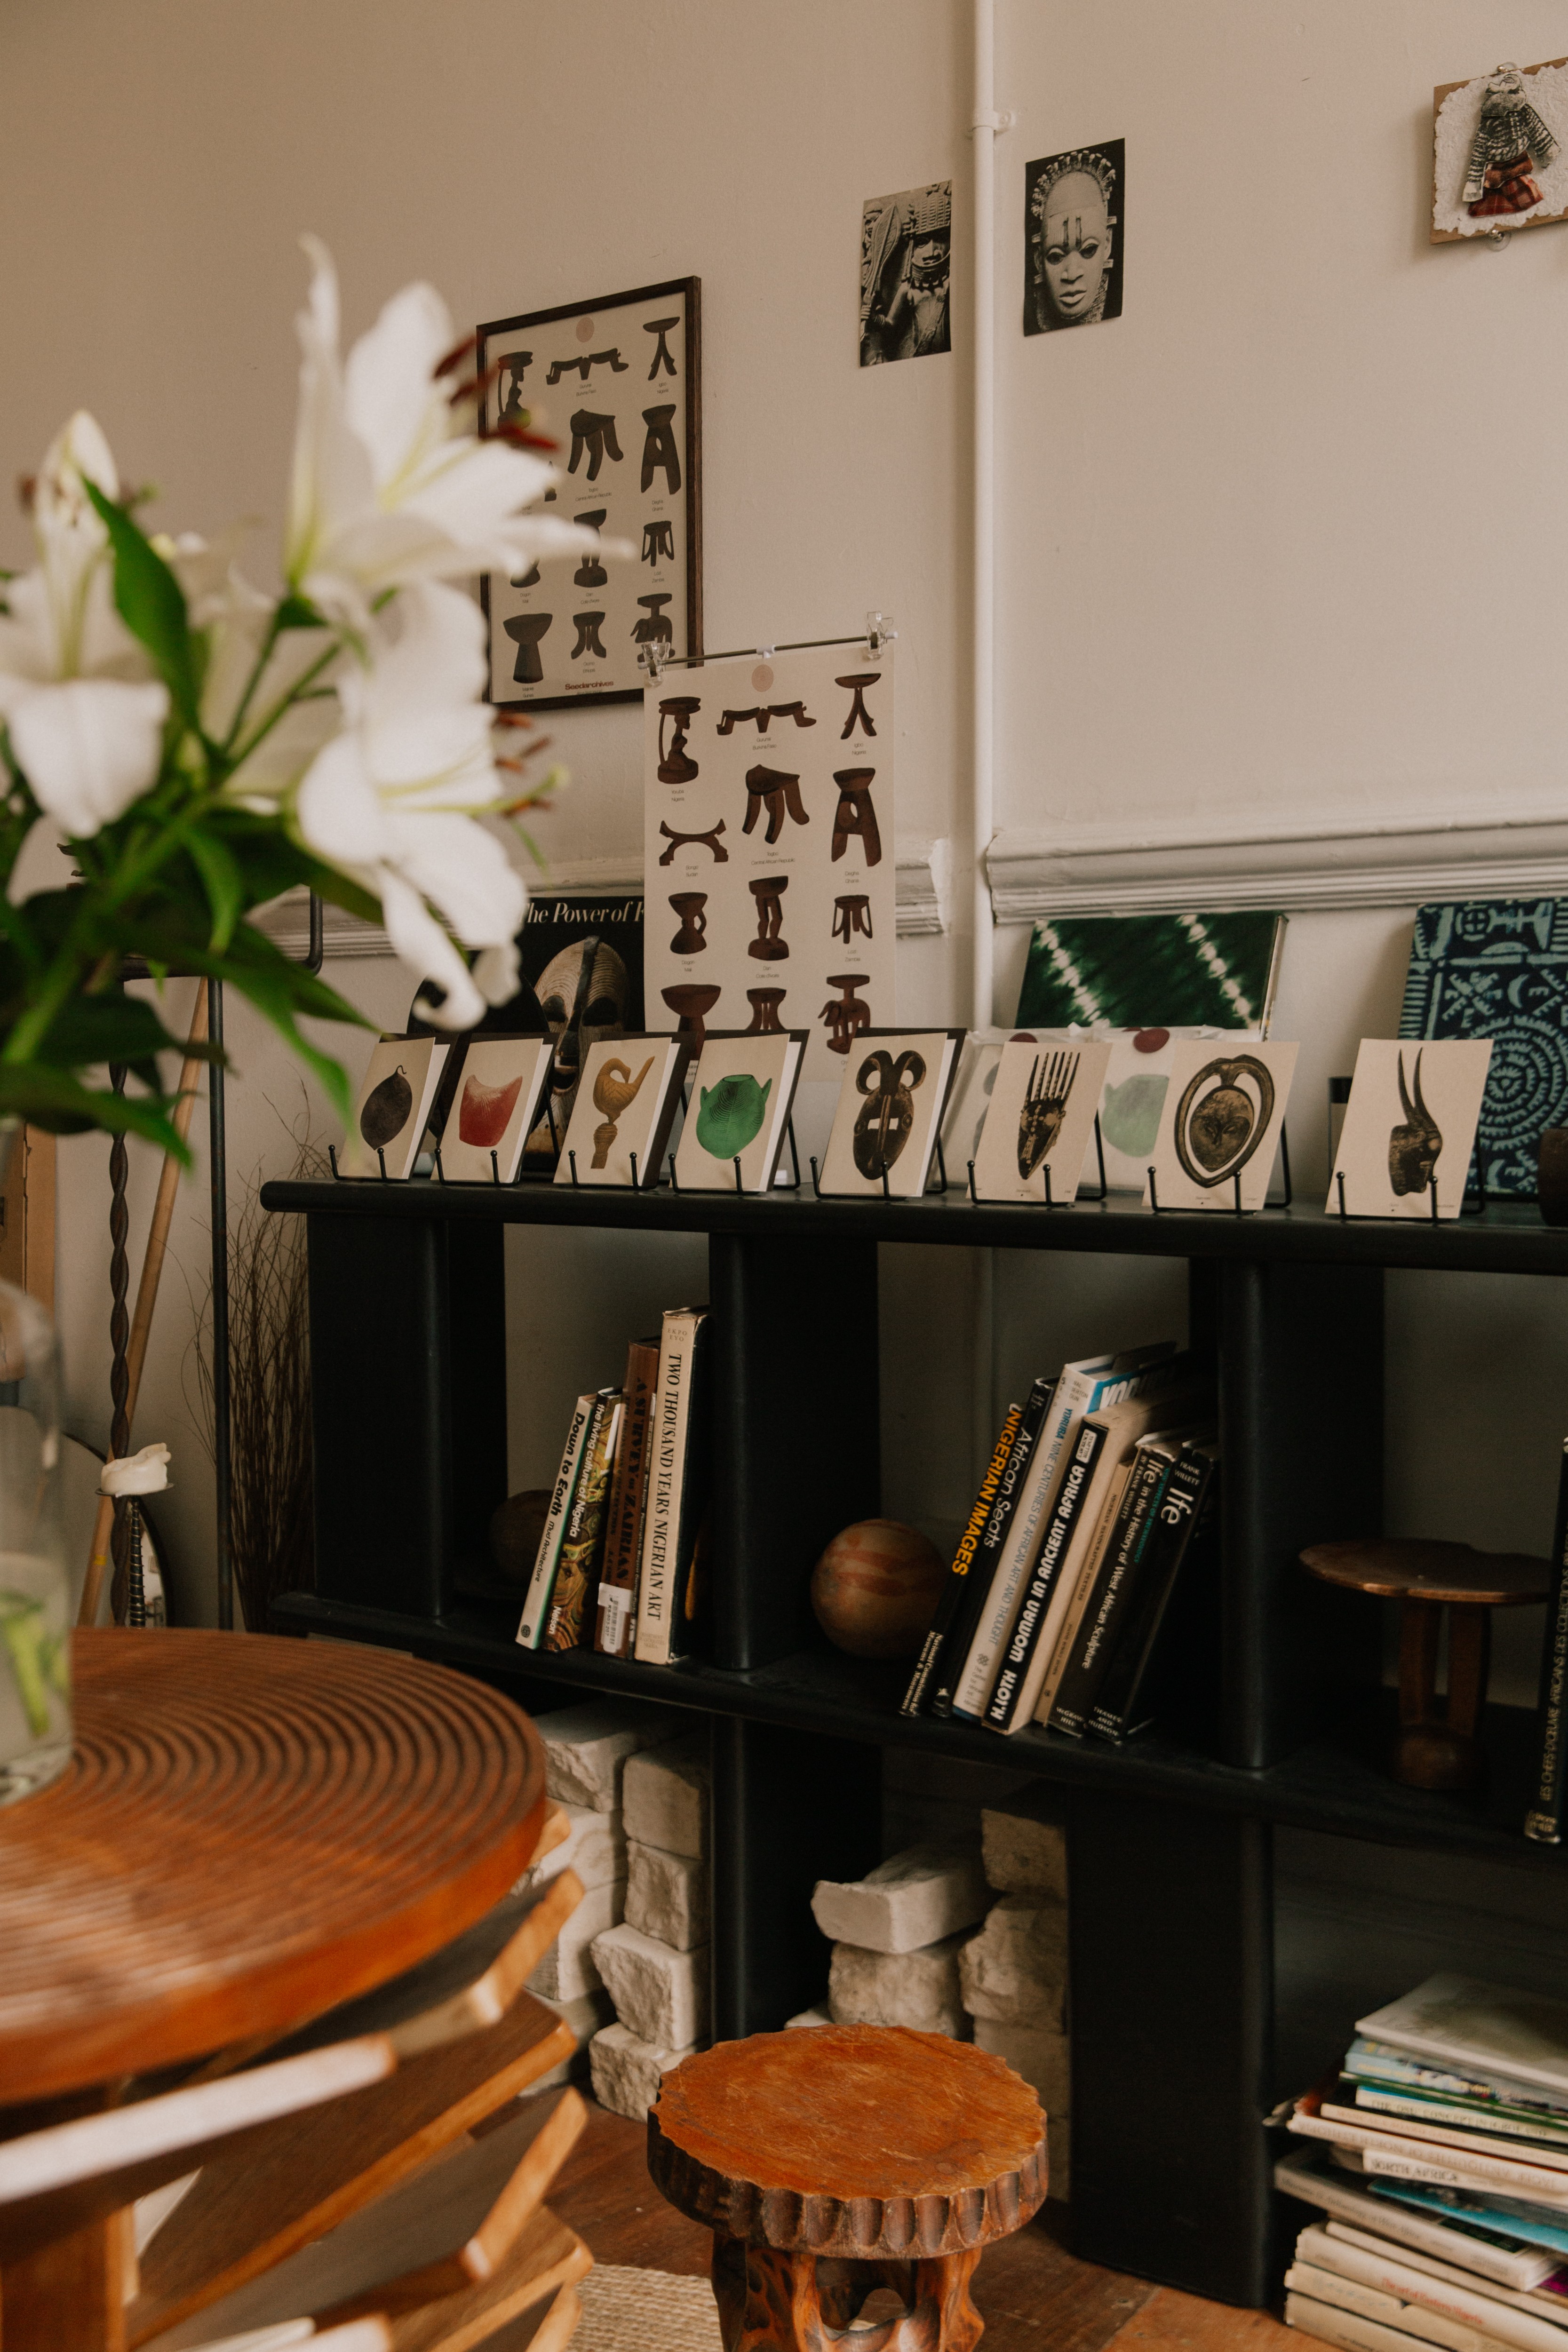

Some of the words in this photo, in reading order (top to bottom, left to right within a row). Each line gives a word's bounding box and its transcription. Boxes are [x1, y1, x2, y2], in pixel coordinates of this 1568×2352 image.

[565, 680, 614, 691] Seedarchives
[553, 902, 609, 923] Power
[611, 900, 633, 922] of
[666, 1354, 682, 1385] TWO
[595, 1403, 605, 1421] the
[566, 1412, 585, 1456] Down
[587, 1421, 602, 1450] living
[660, 1391, 678, 1468] THOUSAND
[978, 1409, 1024, 1501] NIGERIAN
[1001, 1426, 1033, 1491] African
[1047, 1440, 1062, 1462] NINE
[562, 1459, 573, 1475] to
[581, 1452, 593, 1486] culture
[1130, 1464, 1144, 1489] FRANK
[1175, 1469, 1200, 1486] WILLETT
[1179, 1461, 1201, 1476] FRANK
[550, 1478, 568, 1516] Earth
[578, 1487, 587, 1499] of
[655, 1472, 672, 1514] YEARS
[1030, 1463, 1055, 1512] CENTURIES
[1056, 1462, 1086, 1518] AFRICA
[1139, 1485, 1152, 1498] in
[569, 1499, 586, 1537] Nigeria
[1026, 1513, 1039, 1526] OF
[1120, 1489, 1134, 1519] WILLETT
[1133, 1497, 1148, 1517] the
[1161, 1486, 1194, 1525] Ife
[546, 1520, 554, 1538] Mud
[950, 1501, 992, 1577] IMAGES
[983, 1502, 1012, 1549] Seats
[1119, 1515, 1141, 1552] History
[535, 1538, 550, 1582] Architecture
[649, 1518, 668, 1590] NIGERIAN
[1013, 1525, 1035, 1565] AFRICAN
[1036, 1518, 1067, 1580] ANCIENT
[1116, 1551, 1130, 1565] of
[1008, 1563, 1022, 1583] ART
[1108, 1565, 1126, 1591] West
[1001, 1583, 1016, 1604] AND
[1029, 1579, 1048, 1599] IN
[549, 1605, 561, 1635] Nelson
[647, 1591, 661, 1621] ART
[1095, 1590, 1118, 1627] African
[987, 1604, 1010, 1645] THOUGHT
[1008, 1598, 1041, 1664] WOMAN
[917, 1629, 937, 1661] Museums
[925, 1632, 945, 1663] National
[1079, 1623, 1106, 1670] Sculpture
[899, 1669, 922, 1709] Monuments
[910, 1661, 934, 1702] Commission
[989, 1669, 1018, 1721] H.LOTH
[1060, 1716, 1076, 1727] HILL
[1088, 1719, 1119, 1736] HUDSON
[1093, 1706, 1122, 1723] THAMES
[1097, 1716, 1114, 1726] AND
[1371, 2158, 1411, 2176] NORTH
[1412, 2166, 1459, 2183] AFRICA
